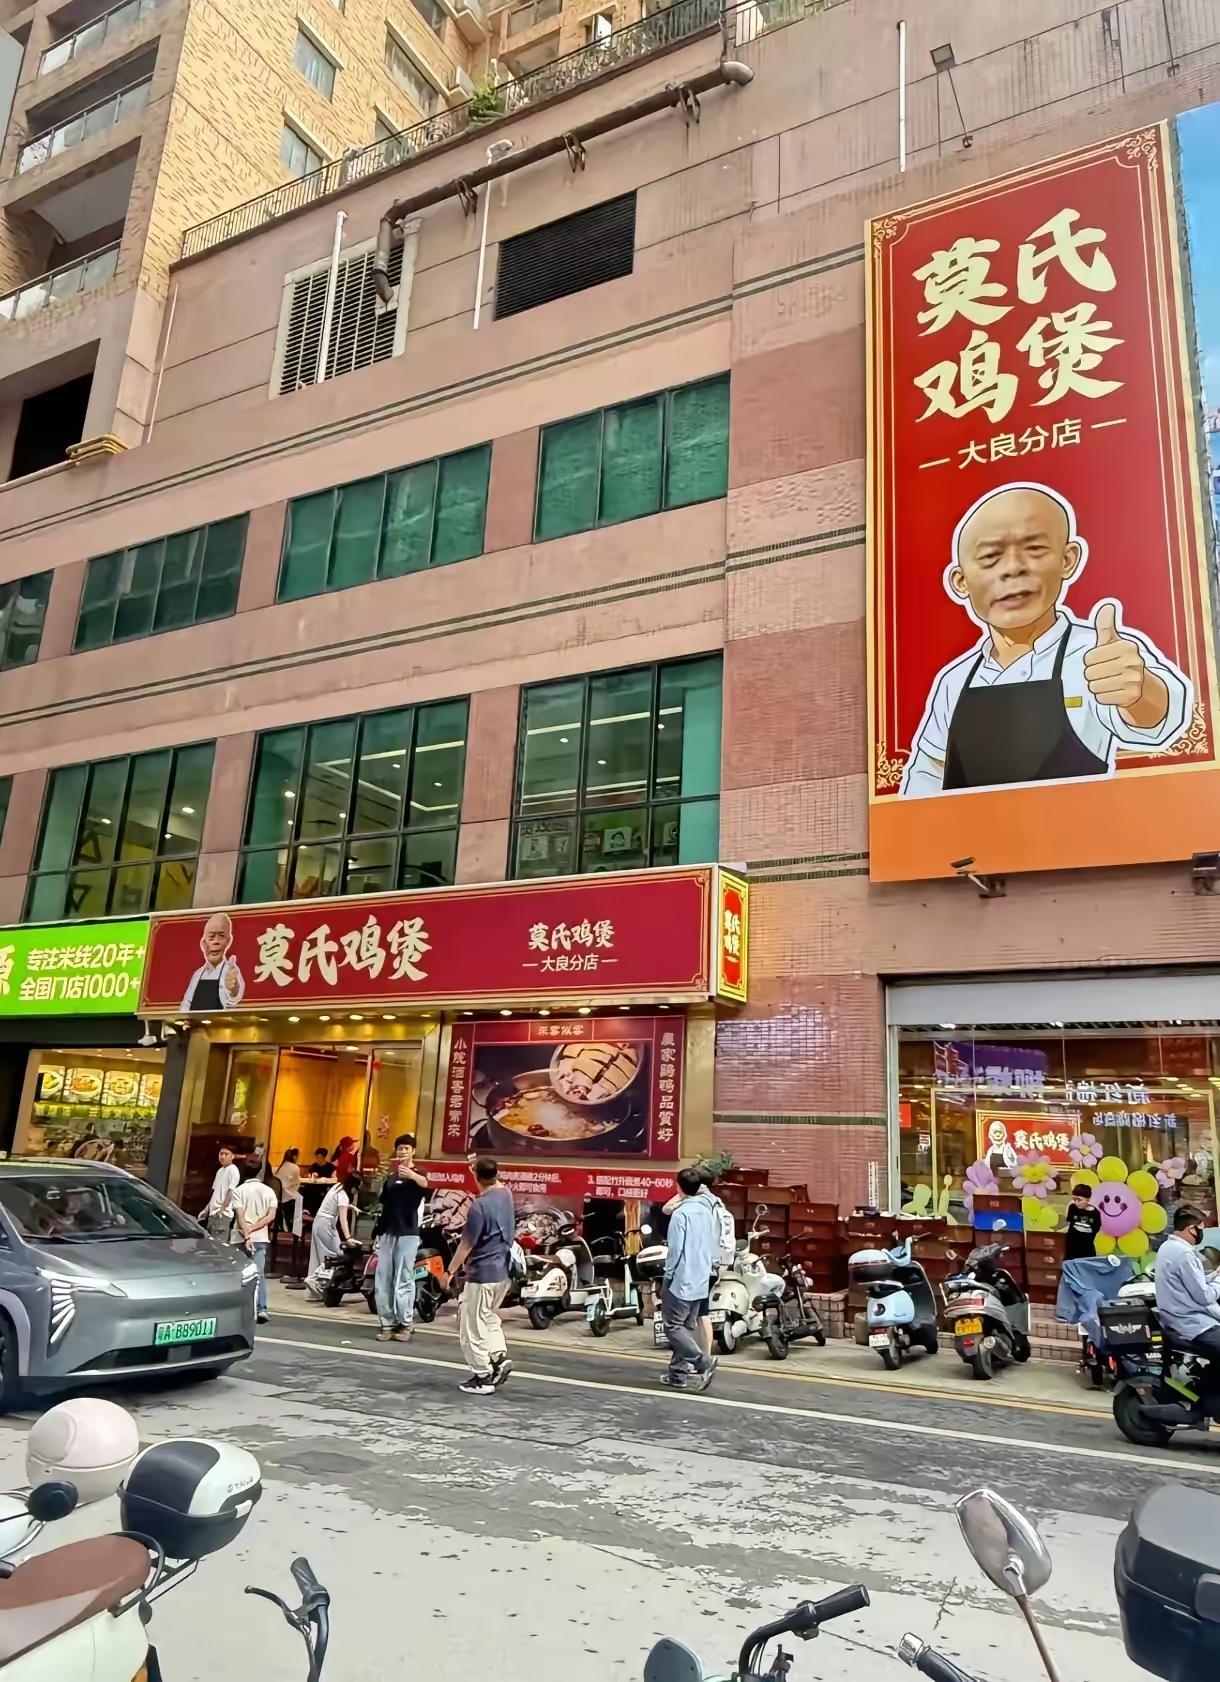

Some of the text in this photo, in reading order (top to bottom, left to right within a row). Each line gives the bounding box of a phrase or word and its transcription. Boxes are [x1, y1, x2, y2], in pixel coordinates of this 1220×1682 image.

[958, 418, 1082, 470] 大良分店
[253, 914, 433, 987] 莫氏鸡煲
[528, 918, 615, 952] 莫氏鸡煲
[540, 953, 599, 973] 大良分店
